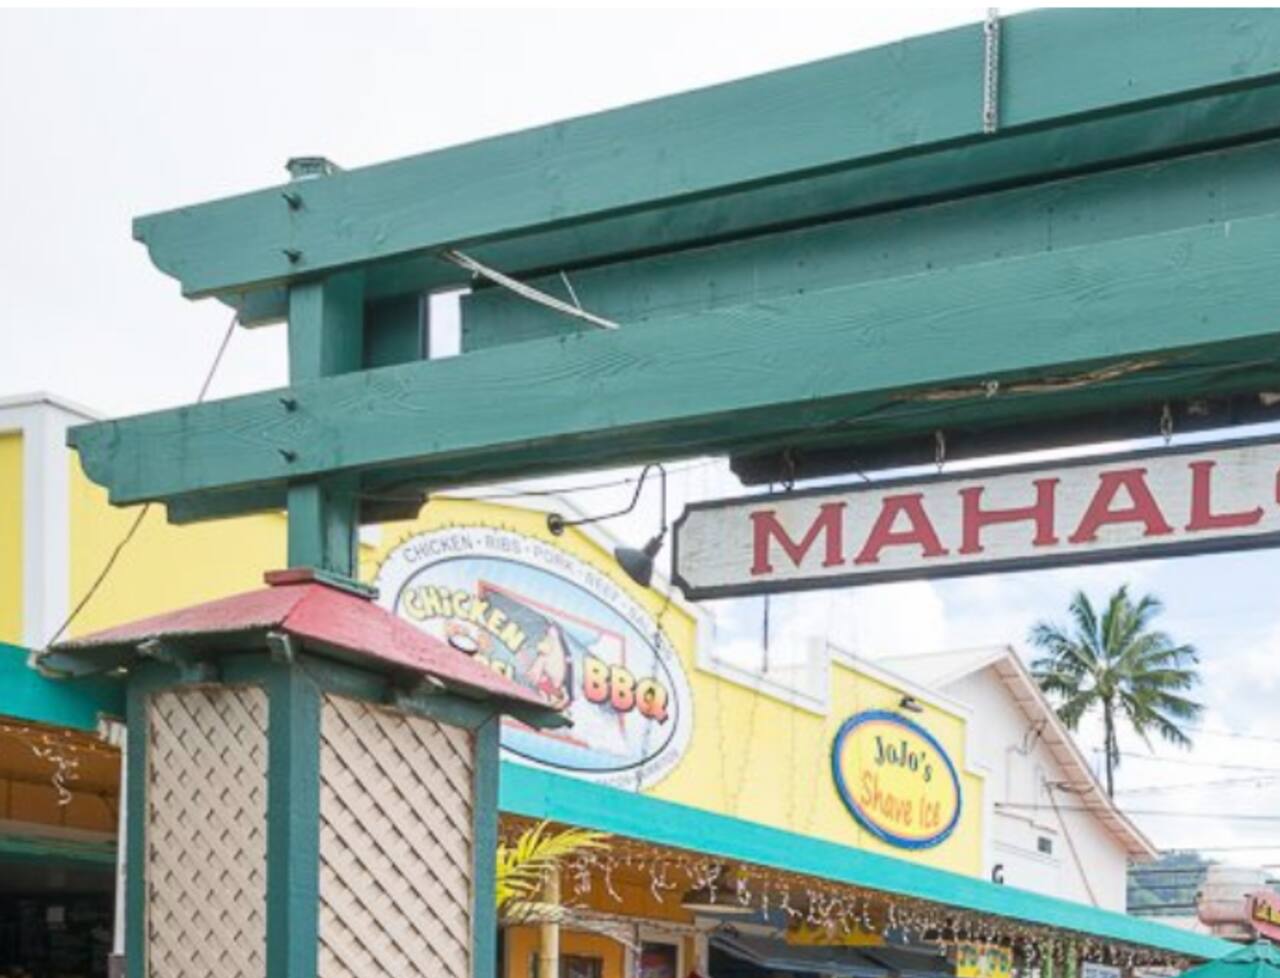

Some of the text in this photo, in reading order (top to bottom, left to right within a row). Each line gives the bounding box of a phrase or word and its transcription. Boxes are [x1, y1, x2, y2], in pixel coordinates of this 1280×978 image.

[402, 534, 472, 563] CHICKEN
[485, 535, 521, 553] RIBS
[583, 655, 669, 725] BBQ
[874, 735, 932, 782] JoJo's
[861, 770, 941, 829] Shave Ice
